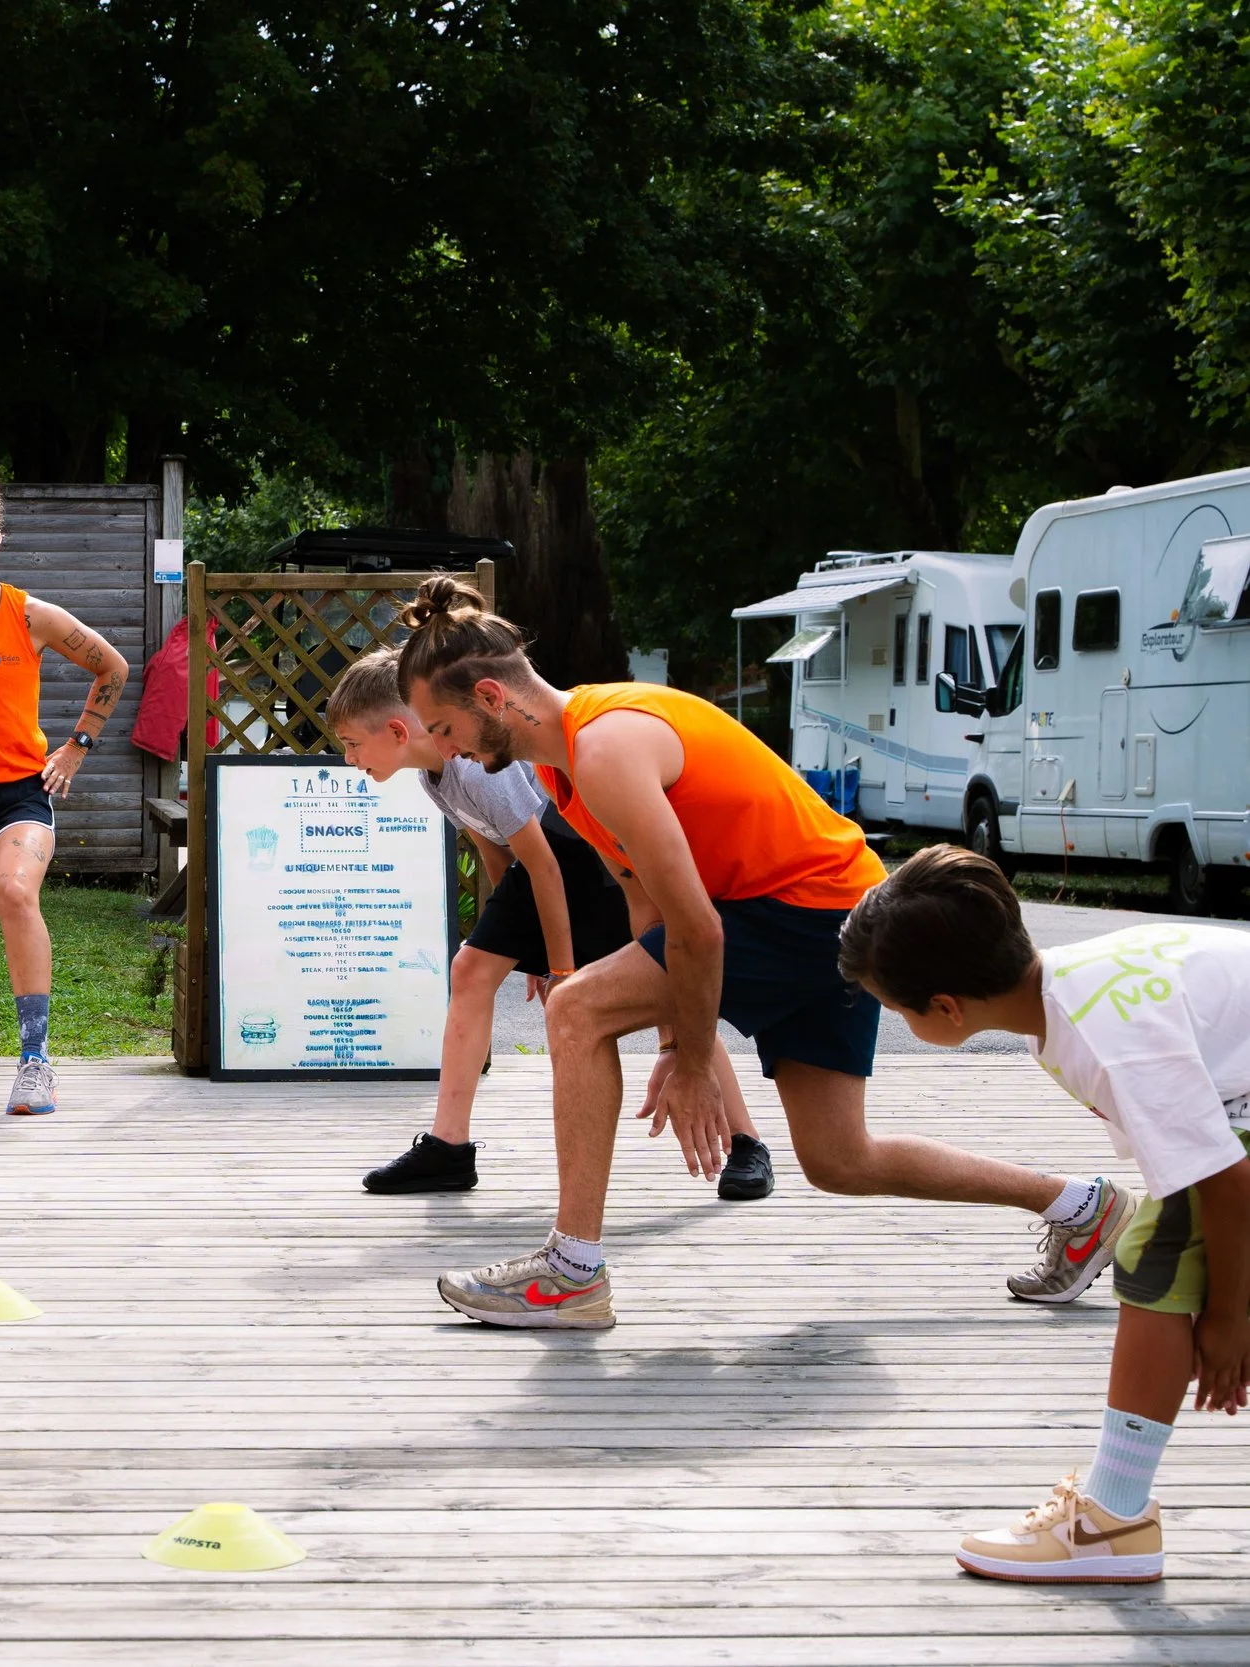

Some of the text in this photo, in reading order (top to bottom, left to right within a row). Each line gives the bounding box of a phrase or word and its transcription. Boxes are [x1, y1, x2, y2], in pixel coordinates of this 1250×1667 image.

[305, 825, 364, 837] SNACKS
[386, 825, 427, 833] EMPORTER
[285, 864, 354, 873] UNIQUEMENT
[371, 864, 394, 873] MIDI
